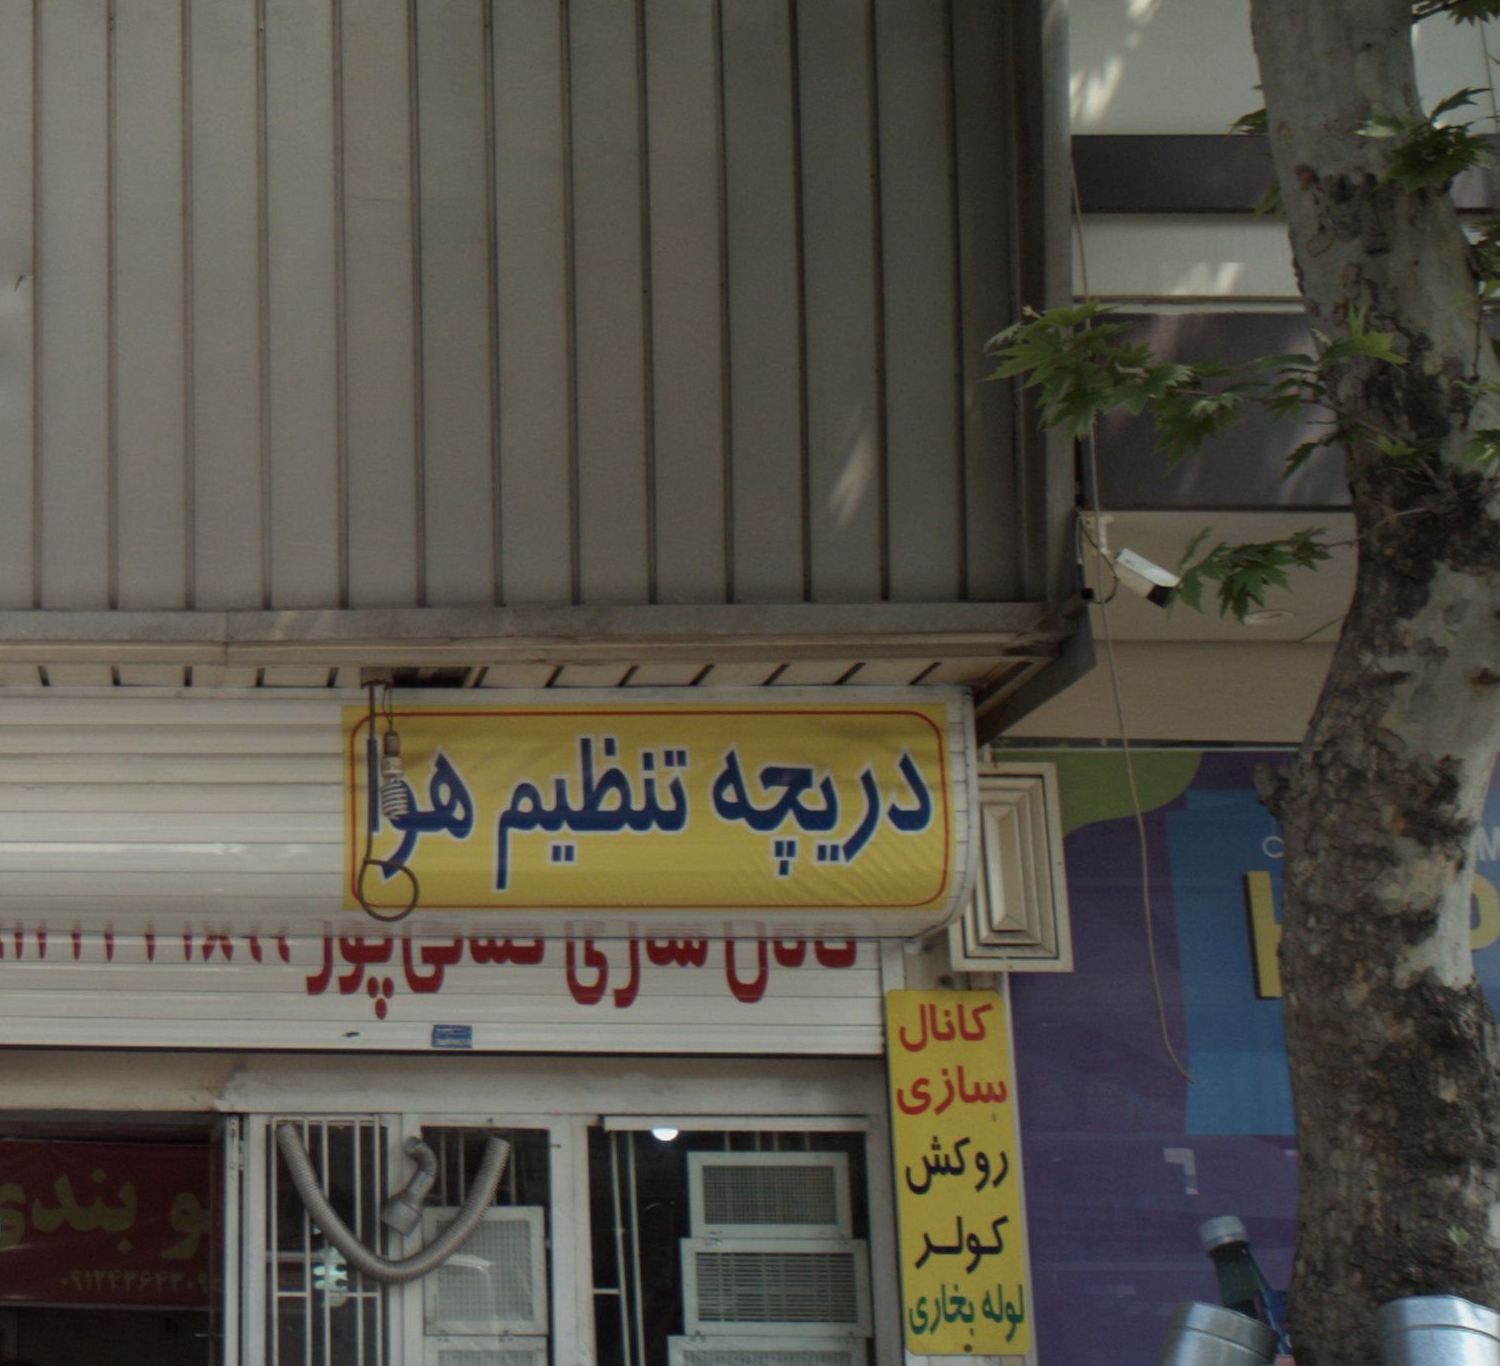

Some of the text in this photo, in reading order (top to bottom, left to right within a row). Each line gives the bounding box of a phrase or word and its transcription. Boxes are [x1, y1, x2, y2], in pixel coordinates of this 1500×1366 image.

[496, 737, 689, 891] تنظیم
[713, 751, 932, 876] دریچه
[899, 1003, 994, 1053] کانال
[896, 1065, 1008, 1116] سازی
[905, 1136, 1010, 1195] روکش
[914, 1216, 1010, 1274] کولر
[908, 1282, 1025, 1344] لوله بخاری
